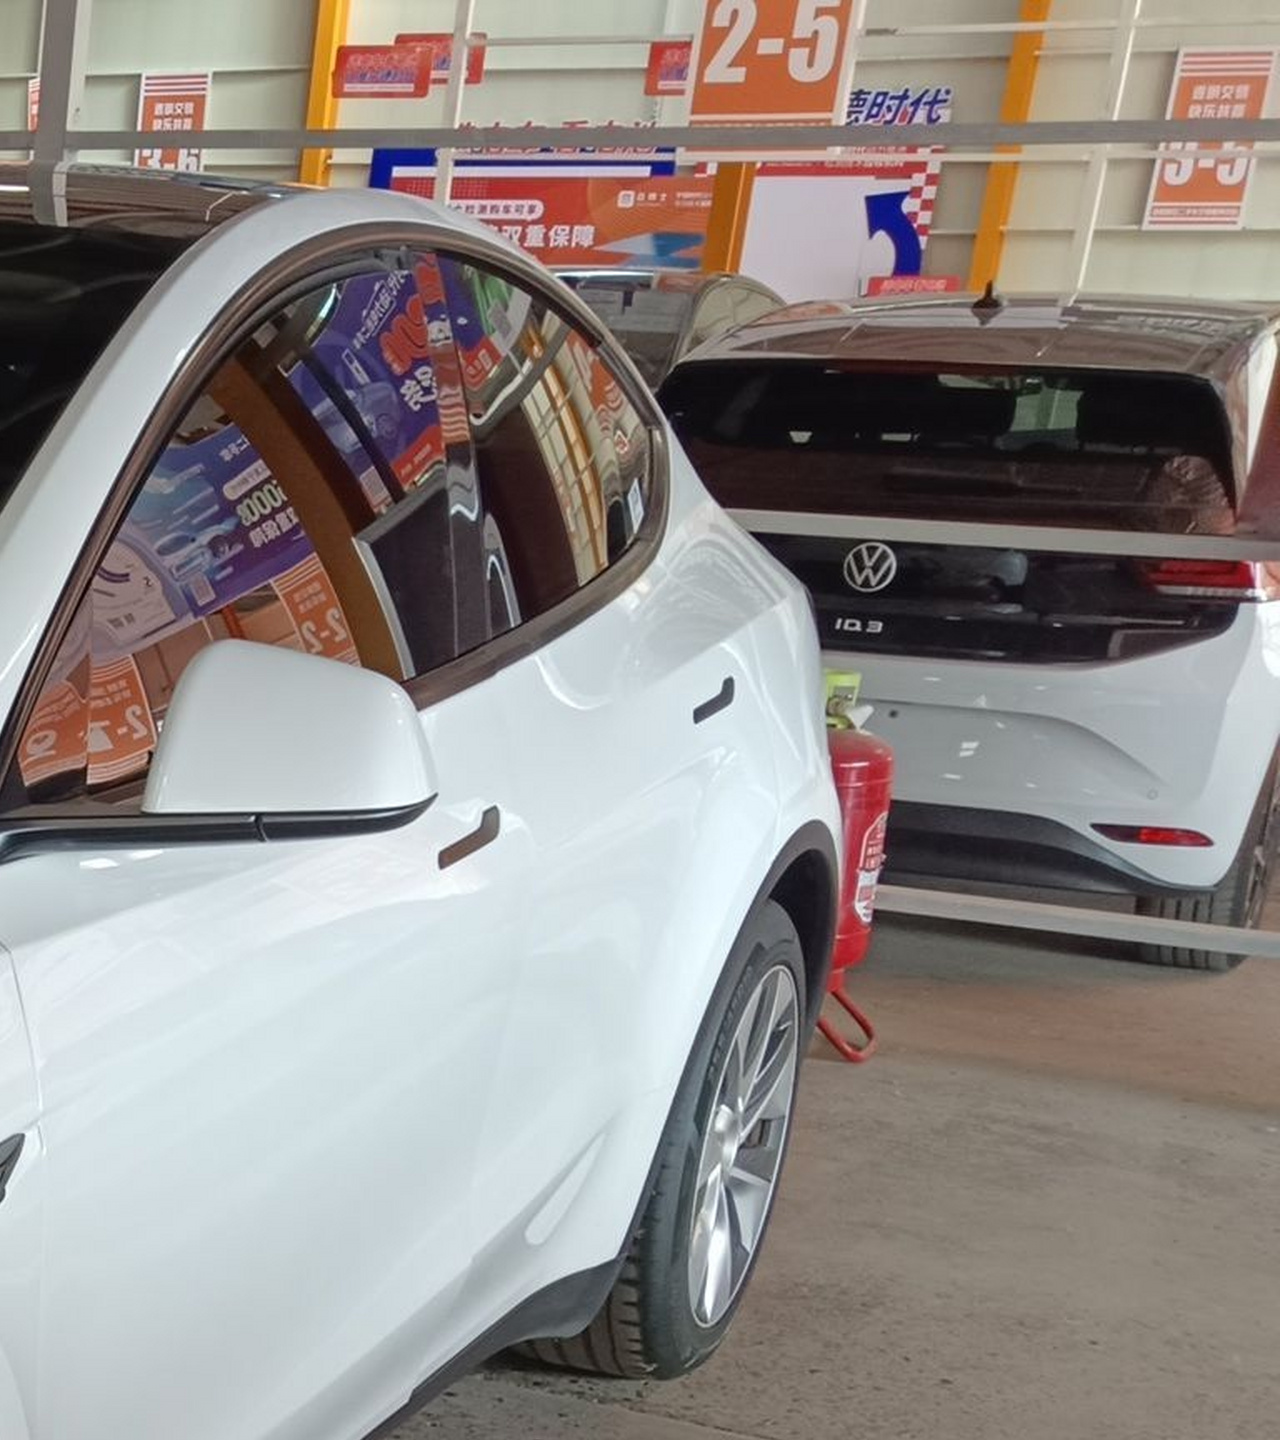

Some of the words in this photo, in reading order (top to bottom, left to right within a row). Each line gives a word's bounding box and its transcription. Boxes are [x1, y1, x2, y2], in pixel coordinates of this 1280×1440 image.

[703, 0, 840, 83] 2-5
[480, 222, 595, 248] 双重保障
